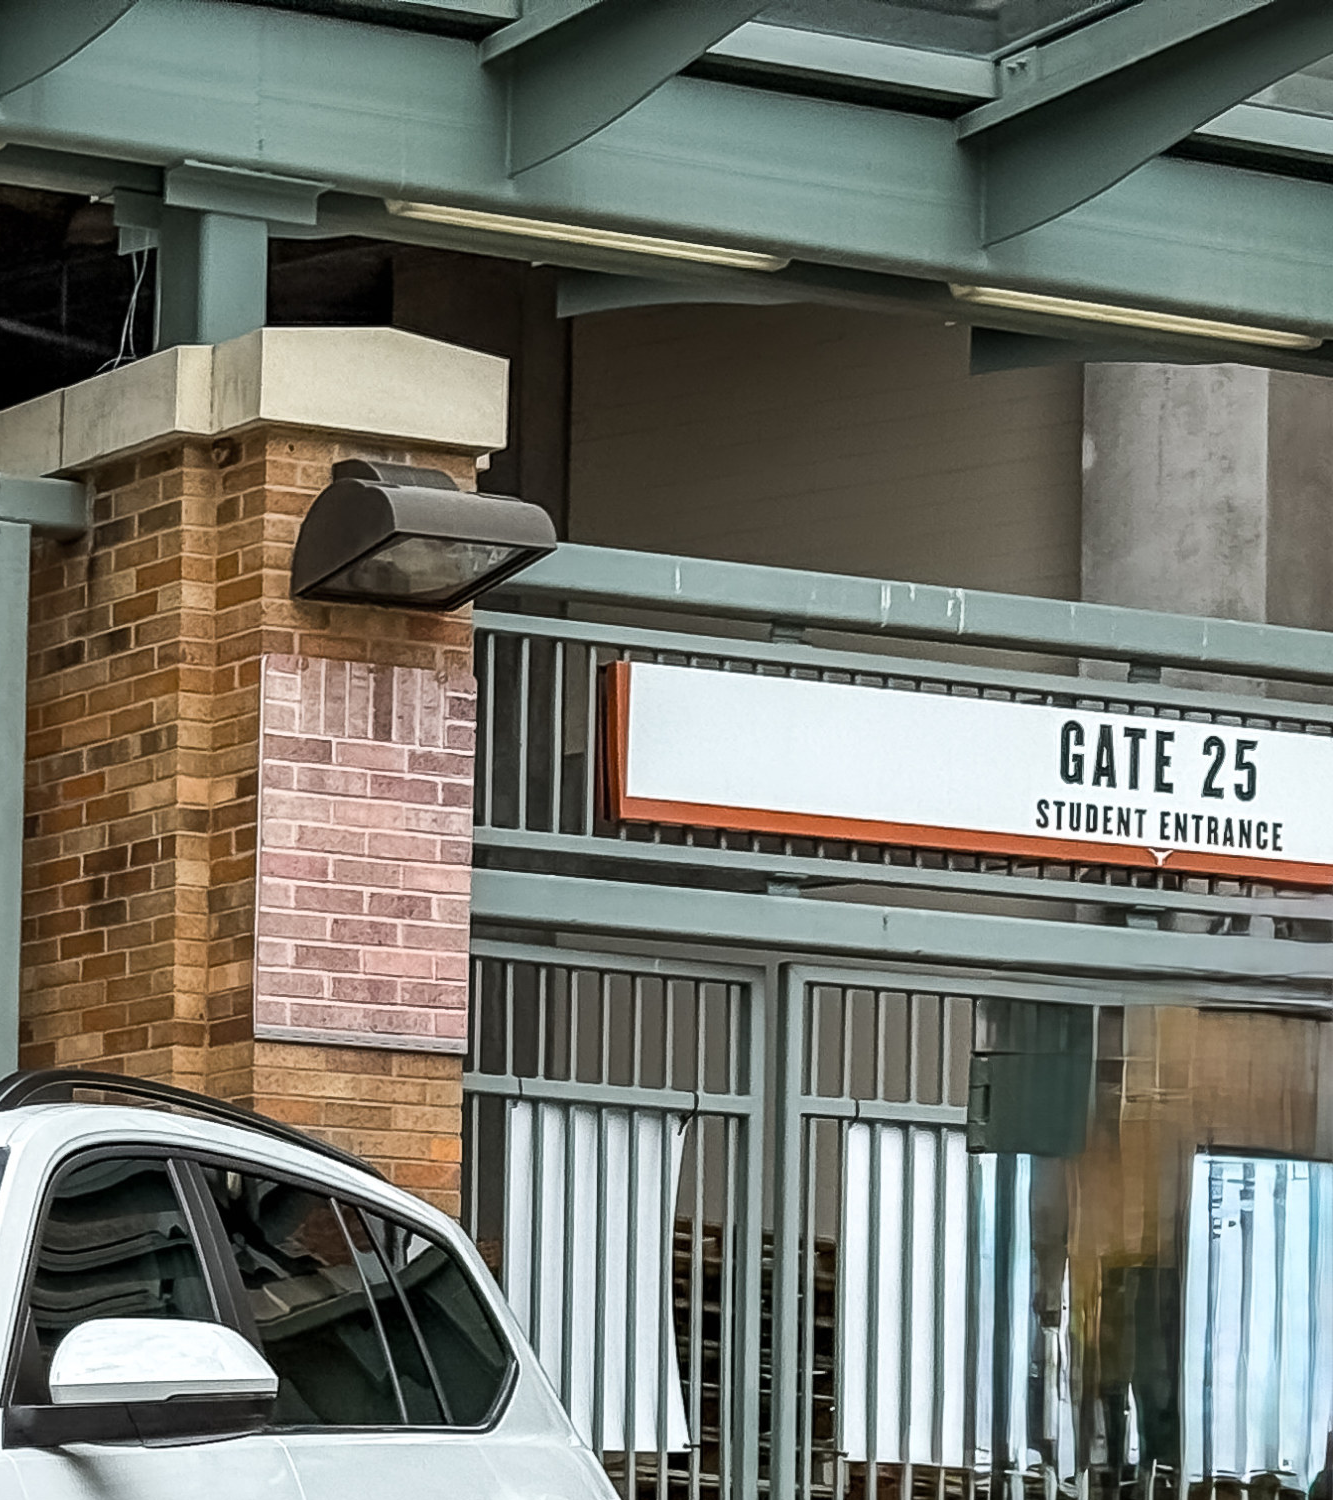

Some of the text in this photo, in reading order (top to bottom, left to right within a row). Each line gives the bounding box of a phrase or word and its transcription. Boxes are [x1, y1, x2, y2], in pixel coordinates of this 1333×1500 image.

[1060, 720, 1259, 802] GATE 25
[1036, 799, 1283, 851] STUDENT ENTRANCE
